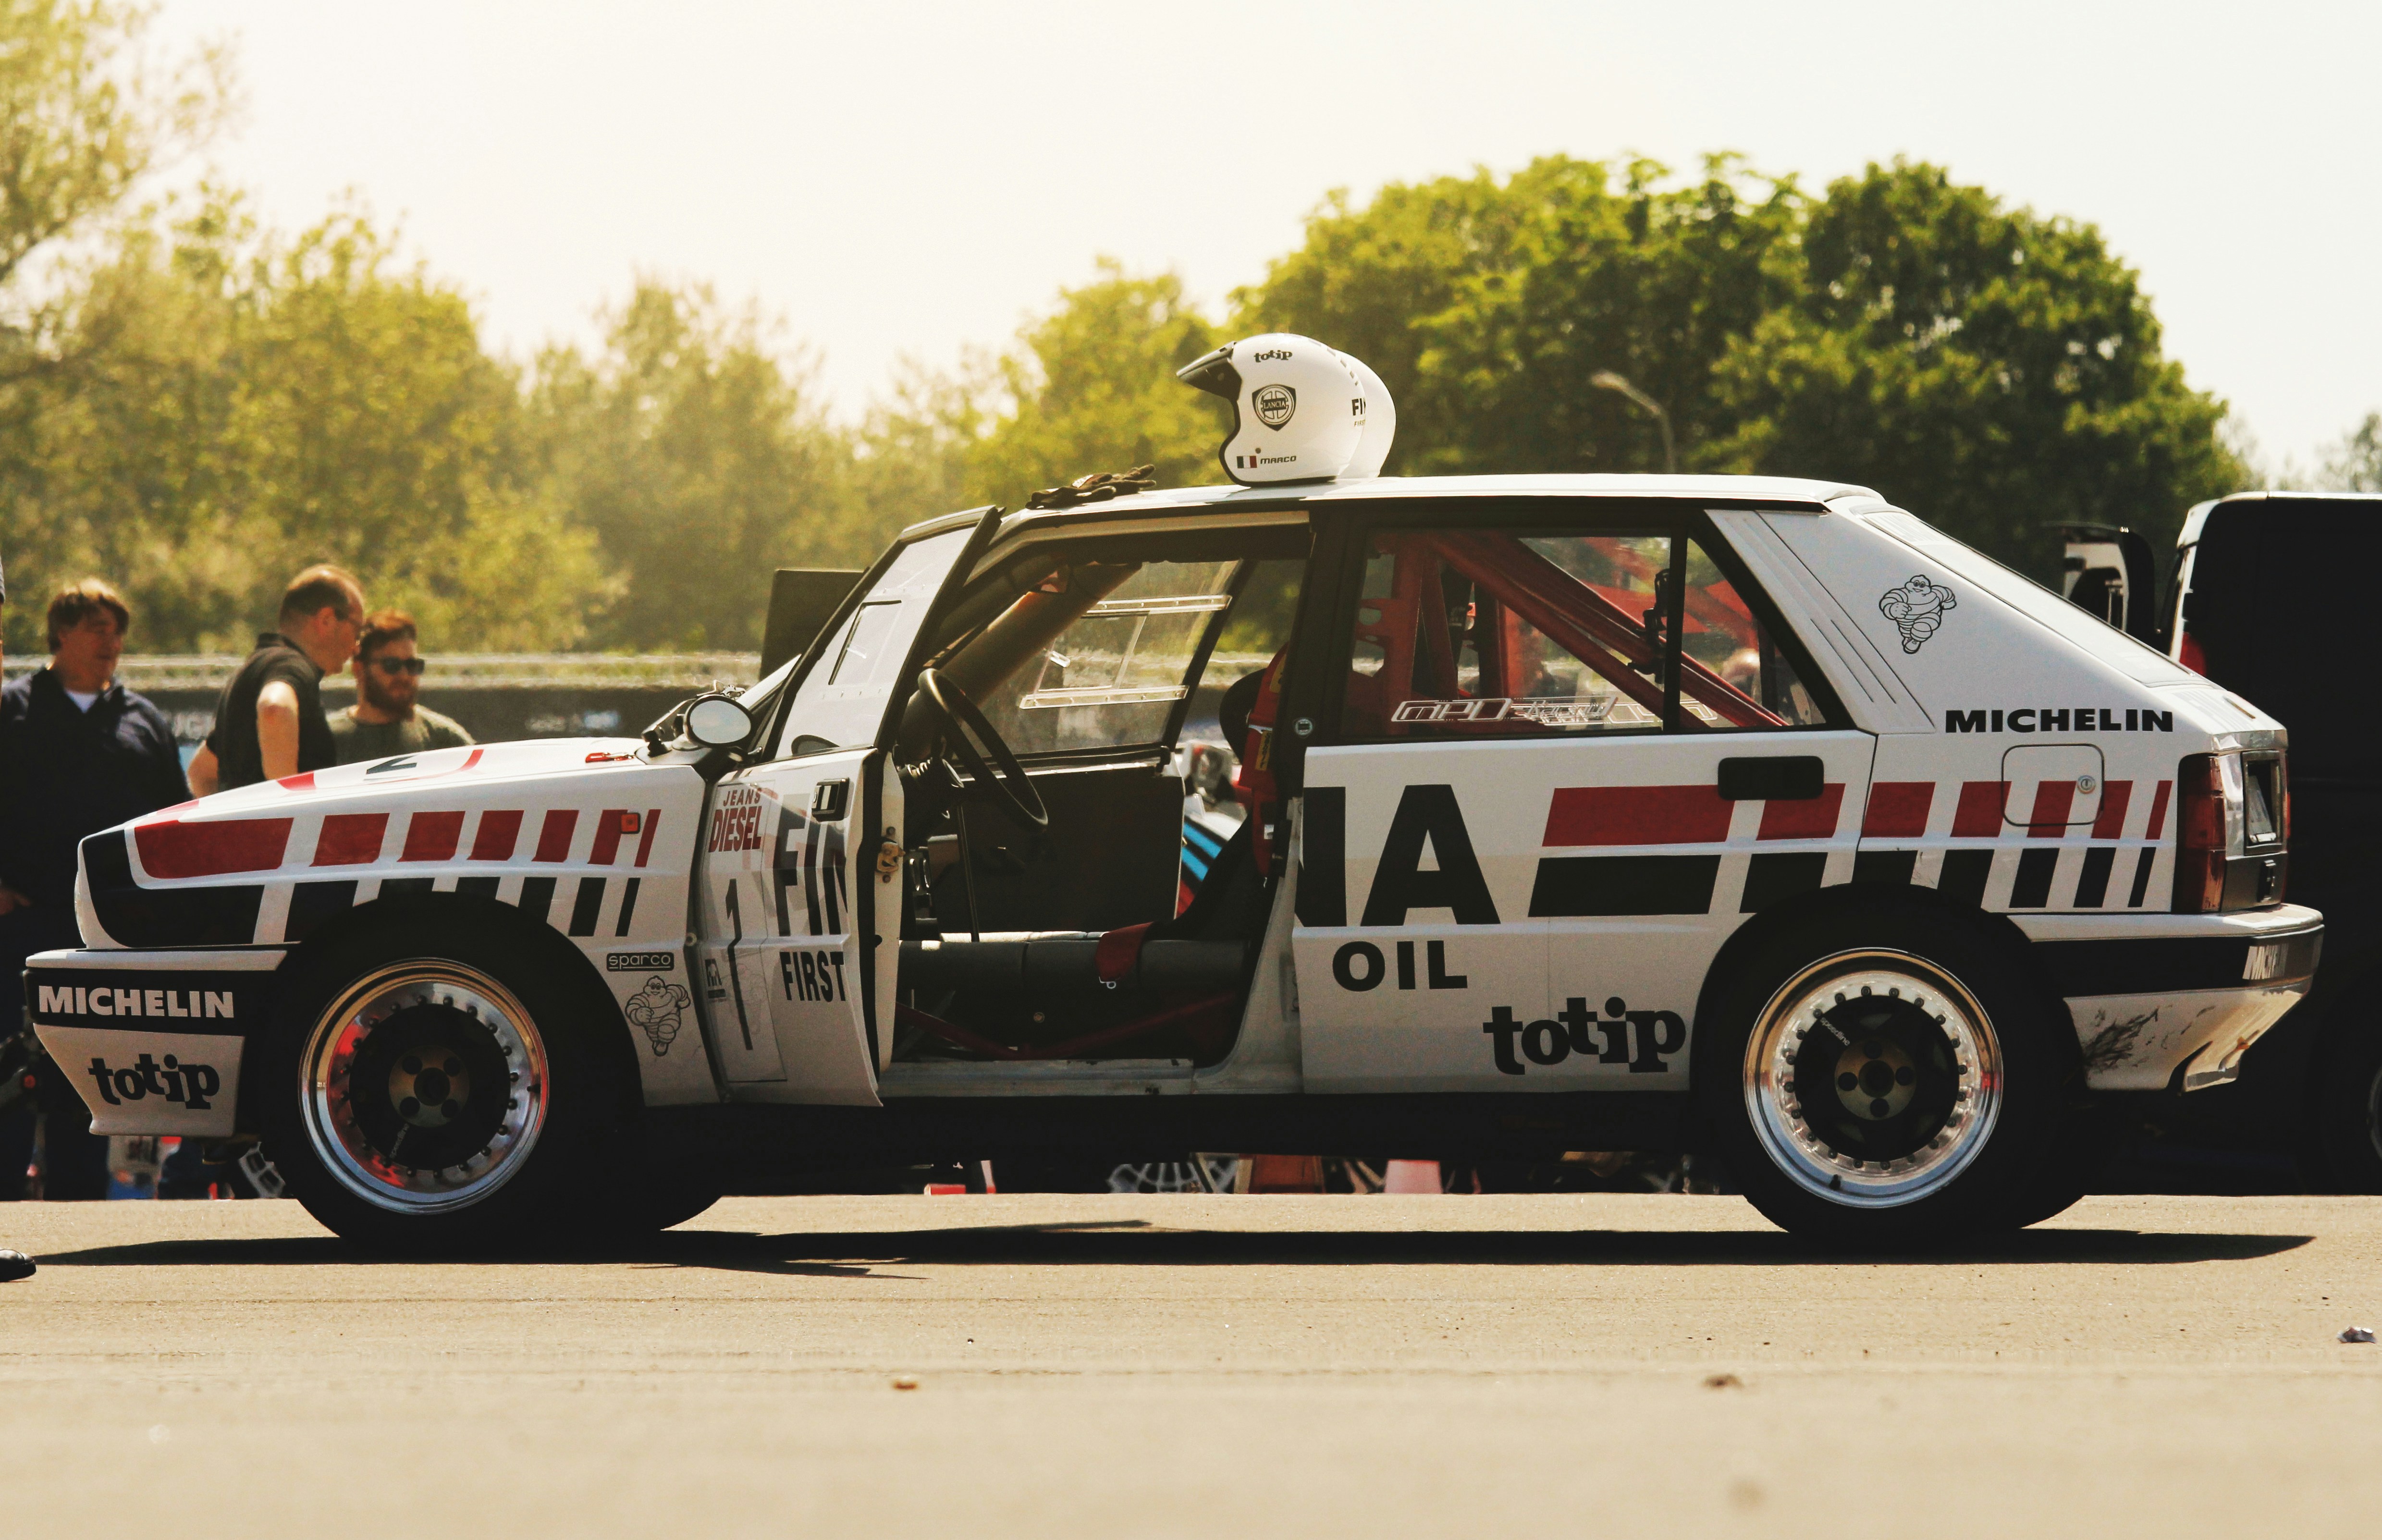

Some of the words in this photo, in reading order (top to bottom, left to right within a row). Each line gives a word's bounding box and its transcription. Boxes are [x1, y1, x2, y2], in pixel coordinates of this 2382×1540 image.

[1254, 350, 1292, 362] totip
[1945, 709, 2173, 733] MICHELIN
[723, 789, 761, 807] JEANS
[708, 806, 762, 853] DIESEL
[608, 954, 671, 970] sparco
[779, 950, 846, 1002] FIRST
[1332, 940, 1468, 992] OIL
[38, 986, 234, 1018] MICHELIN
[1483, 996, 1686, 1076] totip
[1819, 1016, 1850, 1046] speedline
[88, 1053, 220, 1110] totip
